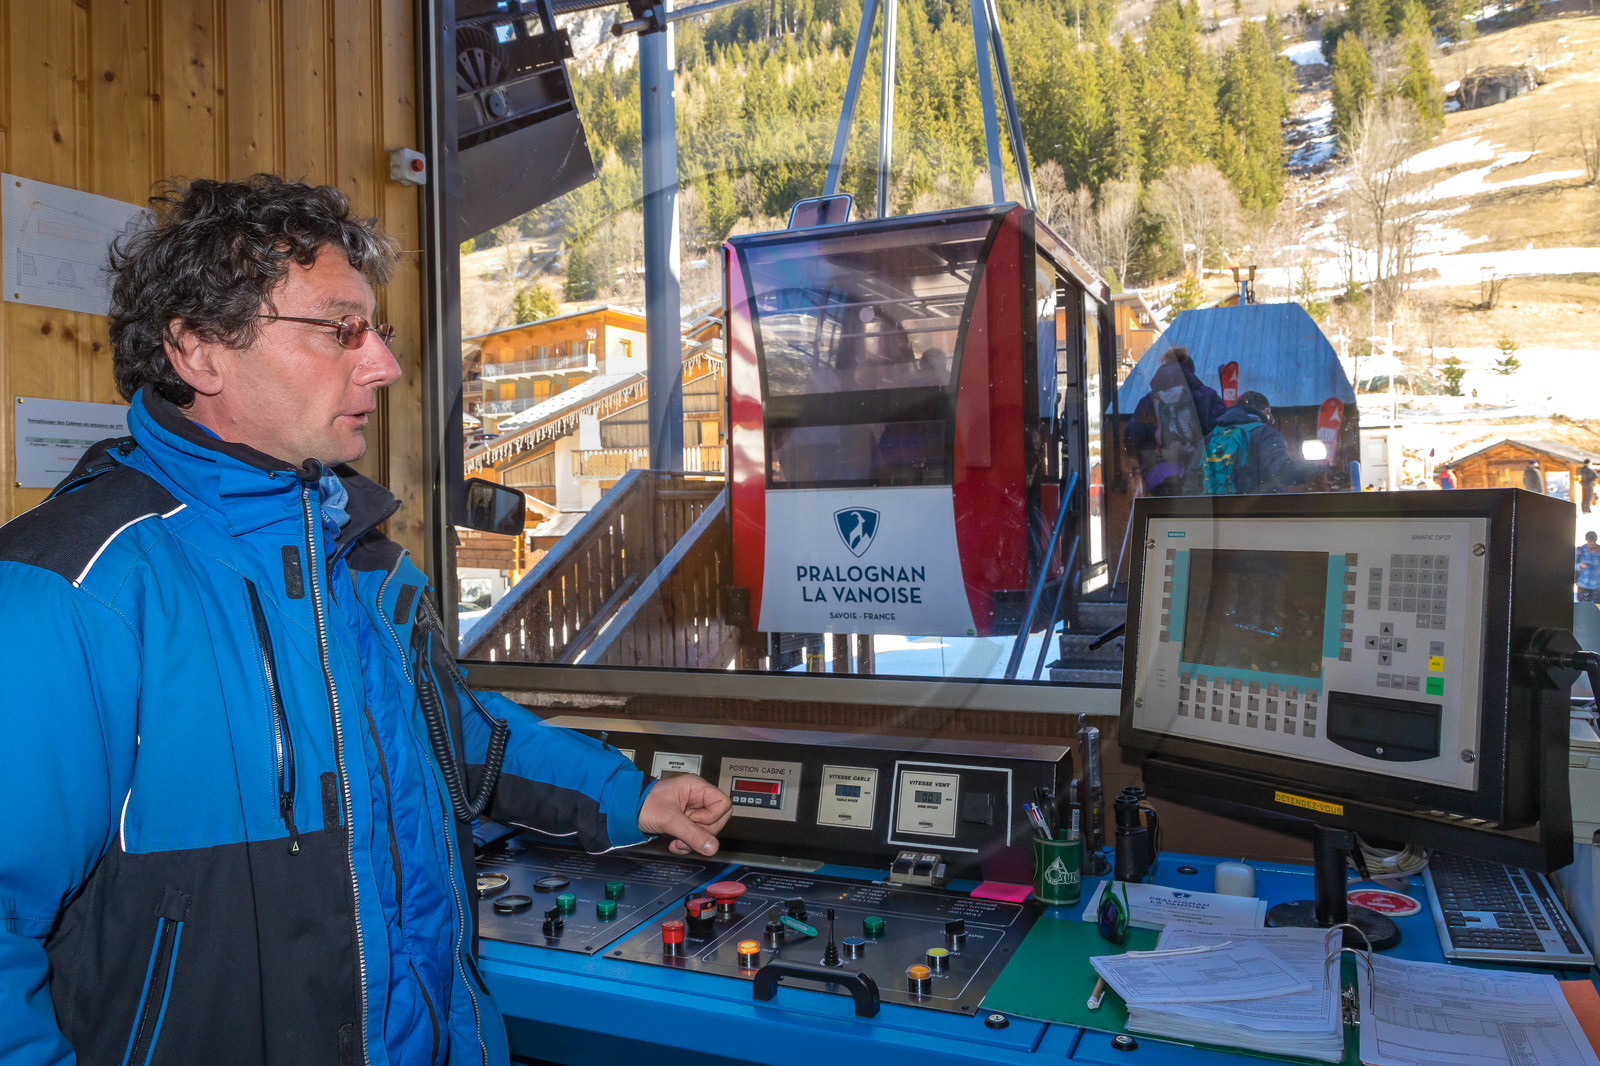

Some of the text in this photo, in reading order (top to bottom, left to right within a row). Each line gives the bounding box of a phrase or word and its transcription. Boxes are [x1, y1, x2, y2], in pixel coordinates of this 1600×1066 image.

[796, 565, 926, 583] PRALOGNAN
[802, 586, 922, 604] LA VANOISE
[829, 612, 858, 620] SAVOIE
[863, 612, 896, 620] FRANCE
[728, 764, 760, 773] POSITION
[761, 767, 786, 775] CABINE
[771, 783, 778, 794] 0
[1149, 896, 1210, 907] PRALOGNAN
[1166, 901, 1207, 910] VANOISE
